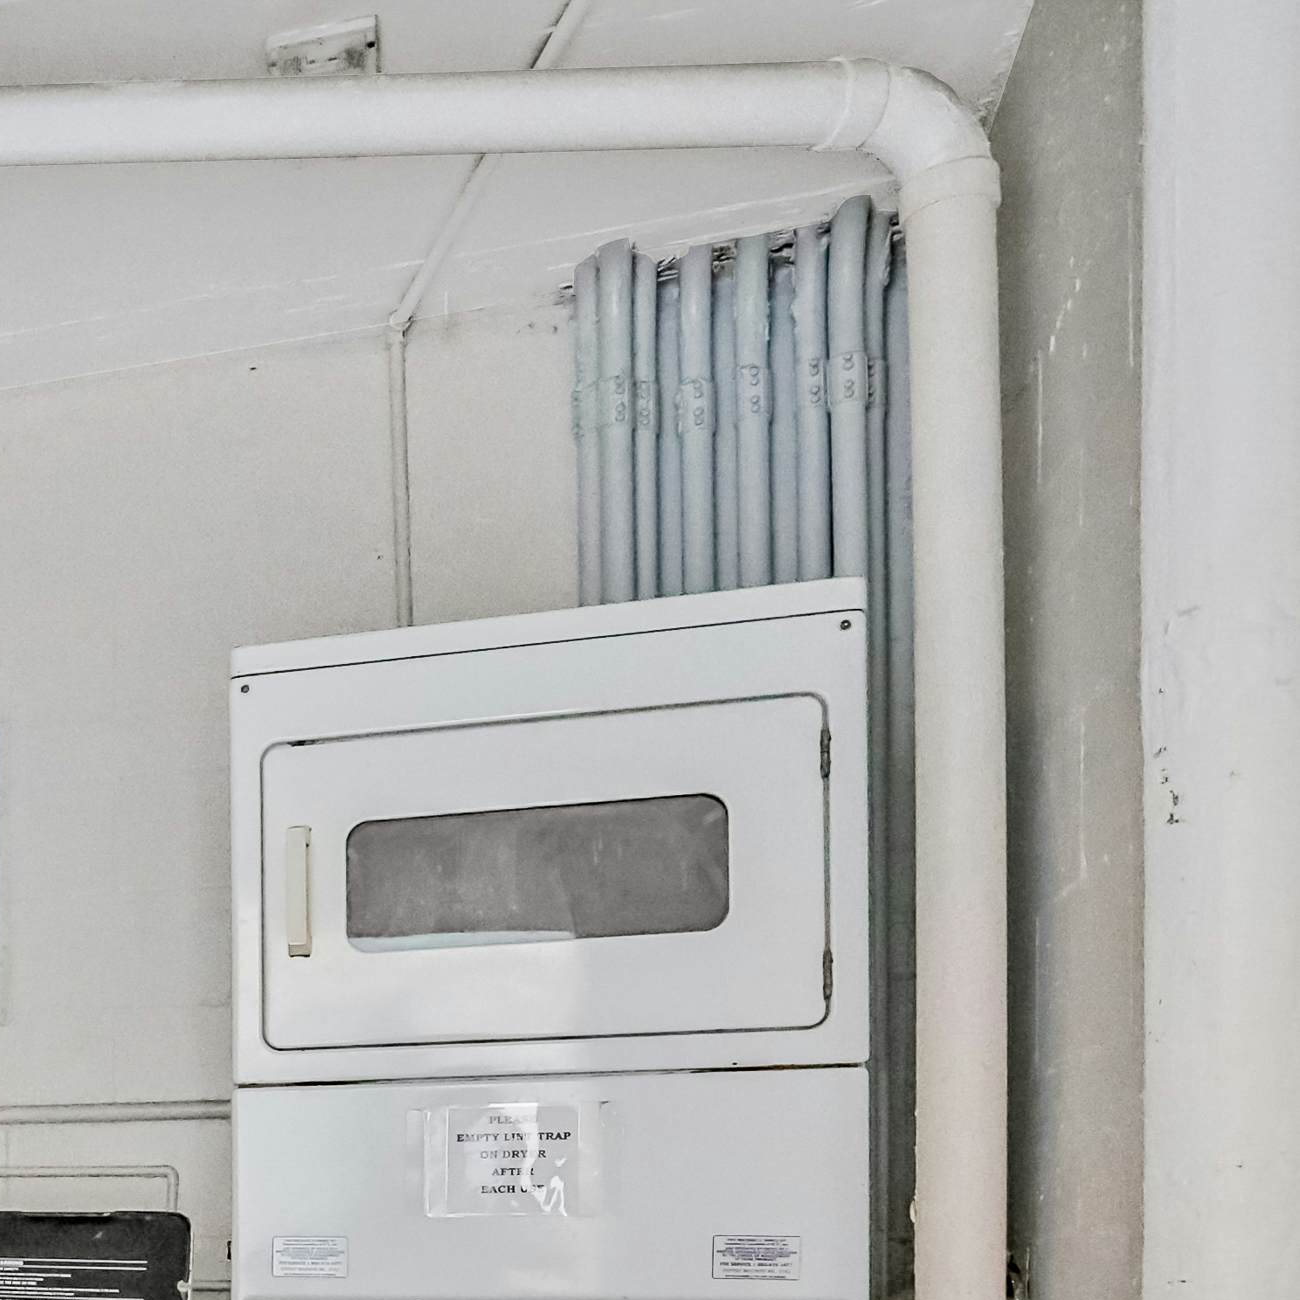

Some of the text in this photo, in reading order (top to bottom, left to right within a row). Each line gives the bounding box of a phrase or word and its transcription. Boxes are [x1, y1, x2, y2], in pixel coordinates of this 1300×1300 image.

[489, 1115, 537, 1125] PLE
[456, 1131, 571, 1143] EMPTY LIN TRAP
[480, 1149, 546, 1159] ON DRYR
[481, 1185, 516, 1194] EACH
